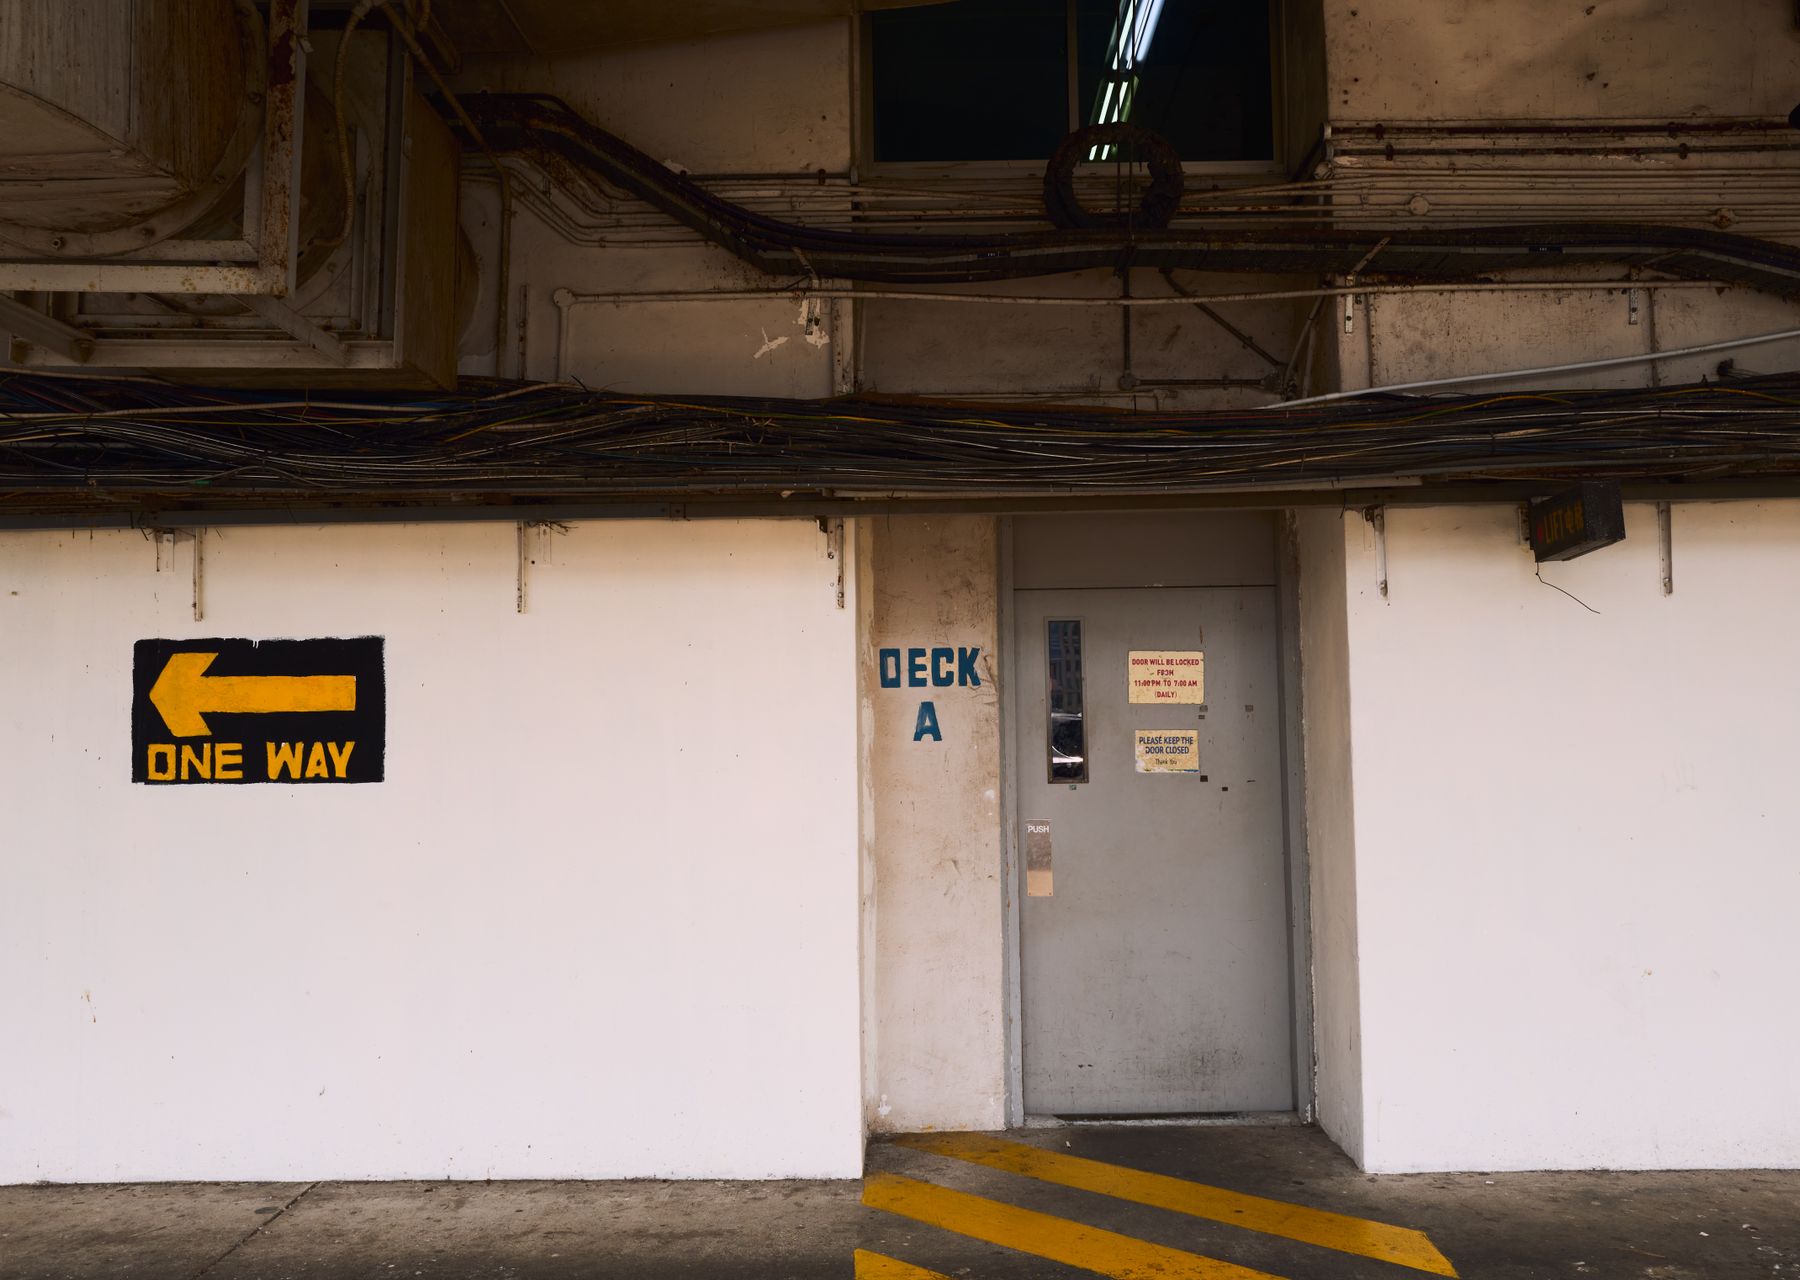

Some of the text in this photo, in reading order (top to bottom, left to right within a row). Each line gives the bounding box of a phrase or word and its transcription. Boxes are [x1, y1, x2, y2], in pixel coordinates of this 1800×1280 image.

[1131, 658, 1200, 666] DOOR WILL BE LOCKED
[879, 647, 981, 688] DECK
[913, 701, 943, 741] A
[1138, 736, 1194, 745] PLEASE KEEP THE
[1145, 746, 1190, 754] DOOR CLOSED
[147, 741, 356, 781] ONE WAY
[1027, 825, 1050, 833] PUSH
